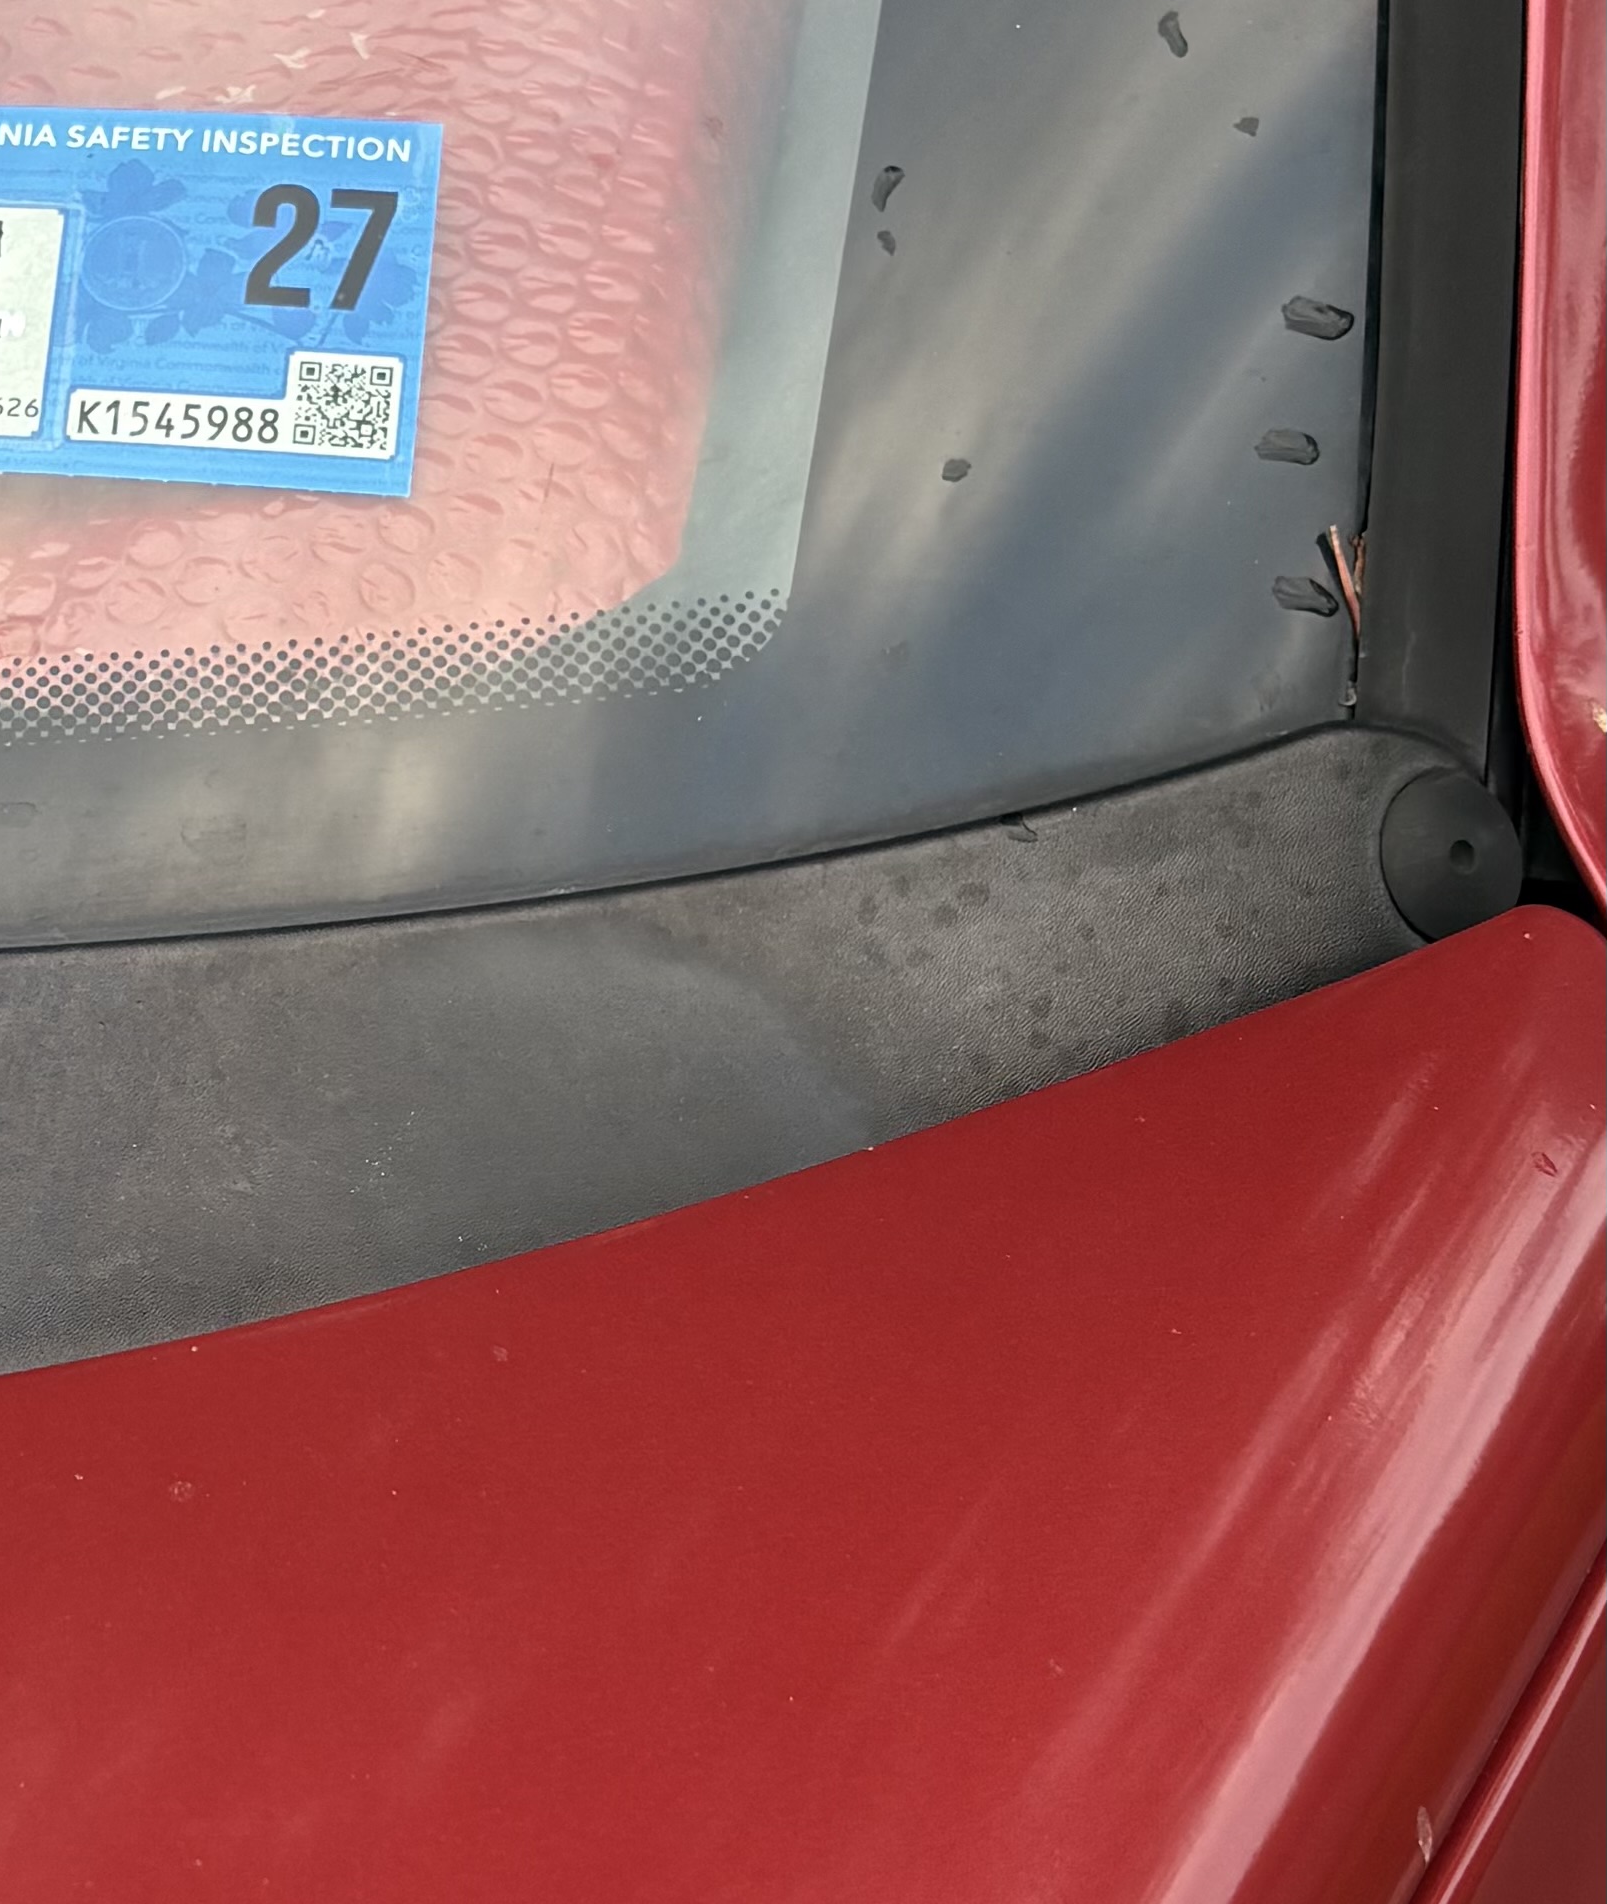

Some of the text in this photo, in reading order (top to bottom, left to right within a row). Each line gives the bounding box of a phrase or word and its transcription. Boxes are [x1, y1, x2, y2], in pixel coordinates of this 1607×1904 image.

[66, 124, 194, 152] SAFETY
[201, 128, 412, 162] INSPECTION
[244, 184, 399, 311] 27
[76, 399, 280, 444] K1545988
